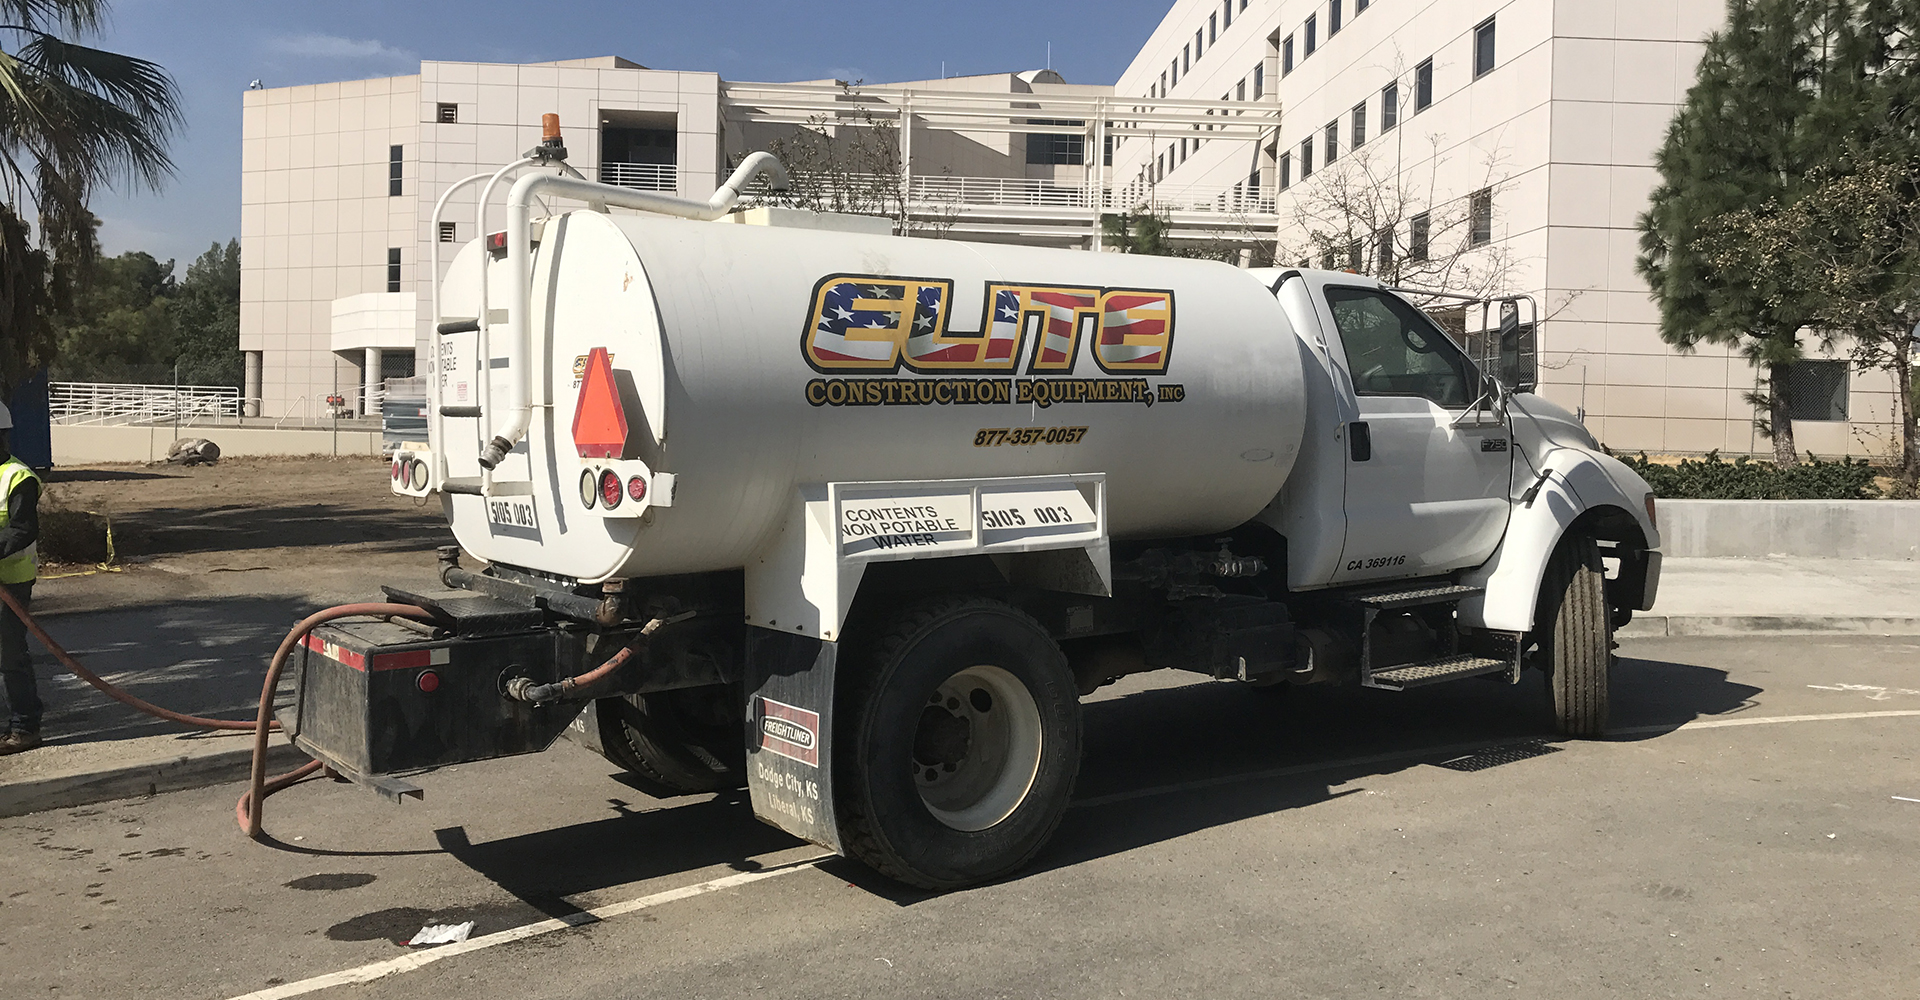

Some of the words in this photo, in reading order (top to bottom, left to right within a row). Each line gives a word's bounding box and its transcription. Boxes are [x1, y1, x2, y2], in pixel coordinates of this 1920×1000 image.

[801, 273, 1175, 375] ELITE
[806, 379, 1012, 405] CONSTRUCTION
[1016, 379, 1154, 407] EQUIPMENT,
[1158, 385, 1185, 402] INC
[973, 426, 1089, 447] 877-357-0057
[513, 503, 533, 526] 003
[845, 506, 938, 521] CONTENTS
[1033, 506, 1073, 524] 003
[841, 523, 878, 537] NON
[879, 518, 960, 534] POTABLE
[871, 533, 939, 550] WATER
[1347, 560, 1363, 571] CA
[1365, 555, 1406, 569] 369116
[764, 720, 811, 745] FREIGHTLINER
[758, 762, 784, 789] Dodge
[785, 772, 805, 798] City,
[805, 779, 819, 801] KS
[768, 792, 801, 823] Liberal,
[800, 805, 814, 825] KS
